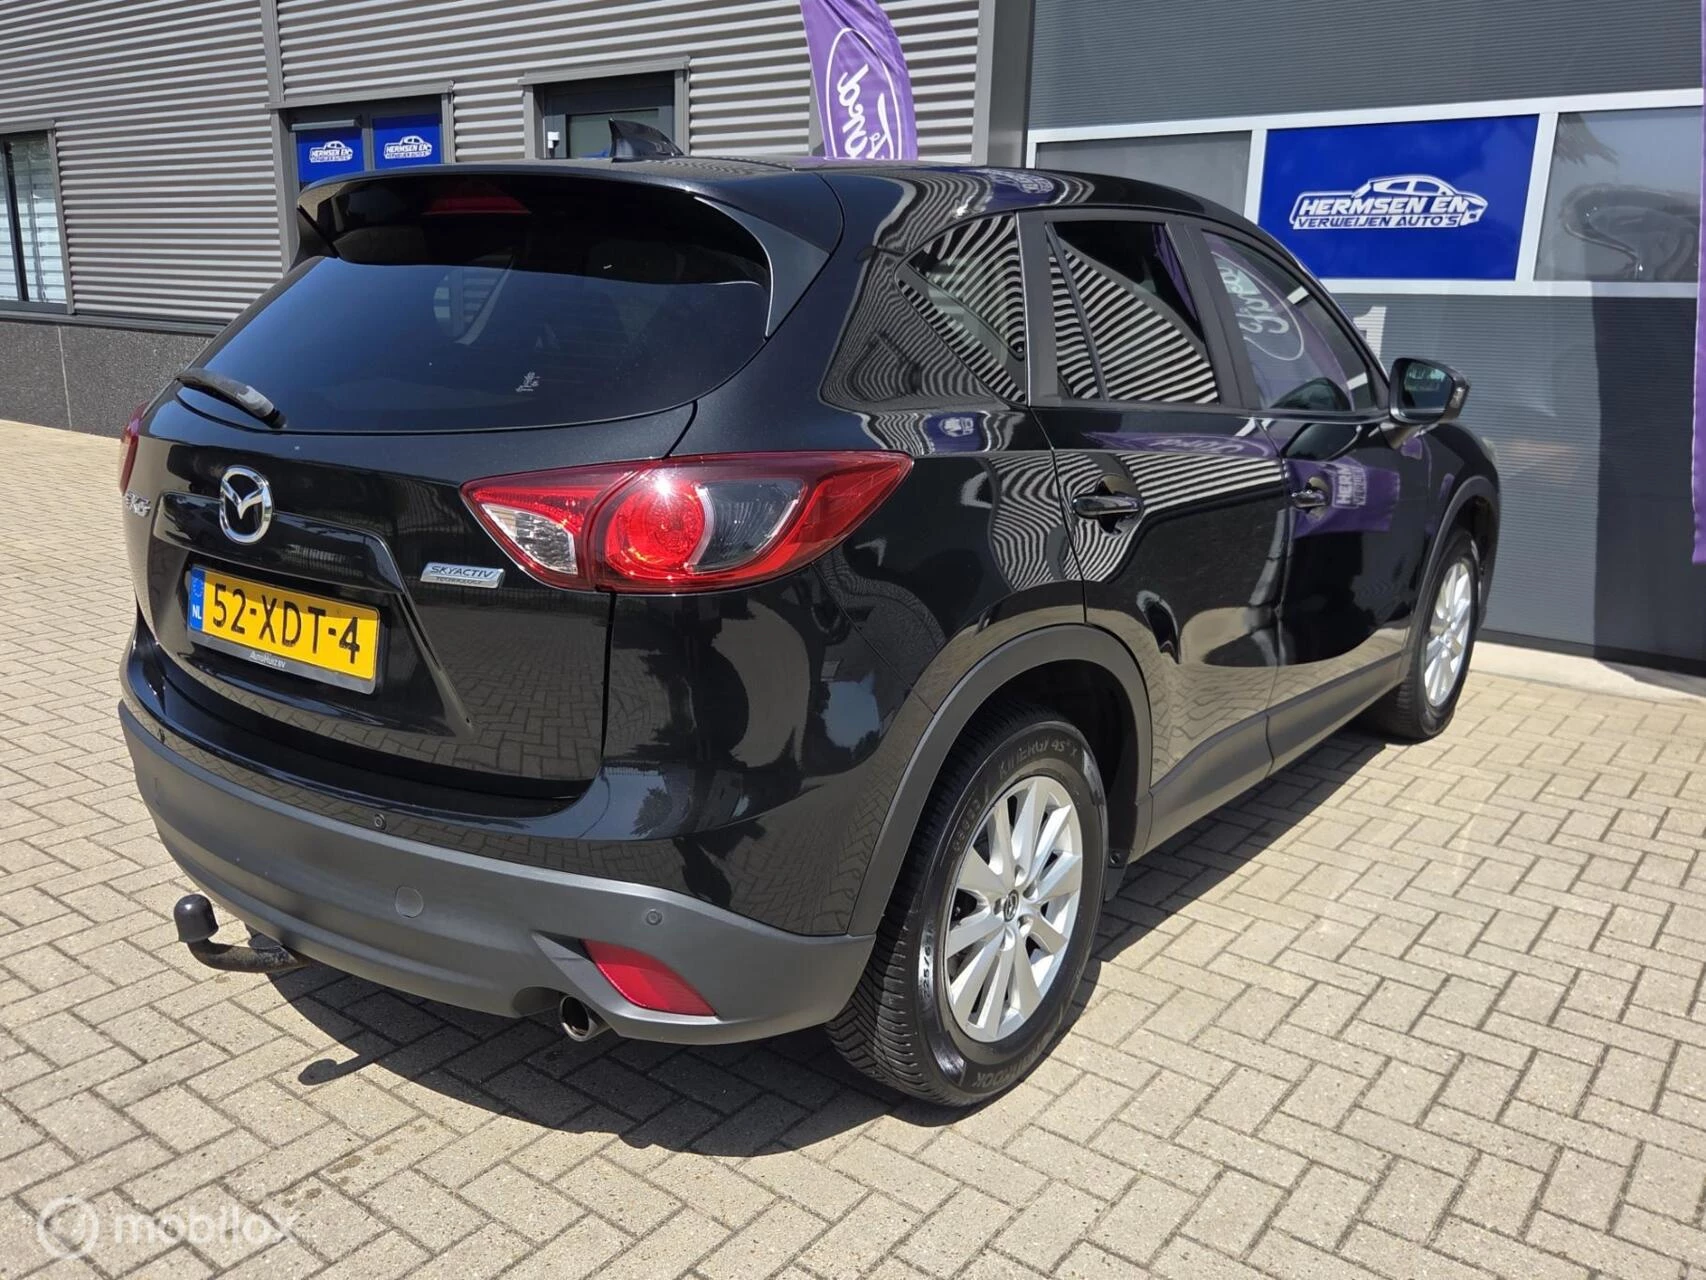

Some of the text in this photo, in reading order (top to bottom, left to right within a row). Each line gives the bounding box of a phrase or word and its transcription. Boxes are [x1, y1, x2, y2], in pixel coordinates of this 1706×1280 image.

[1299, 196, 1468, 216] HERMSEN EN
[1298, 213, 1459, 228] VERWEIJEN AUTO'S
[430, 565, 494, 578] SKYACTIV
[191, 604, 202, 620] NL
[212, 582, 361, 665] 52-XDT-4
